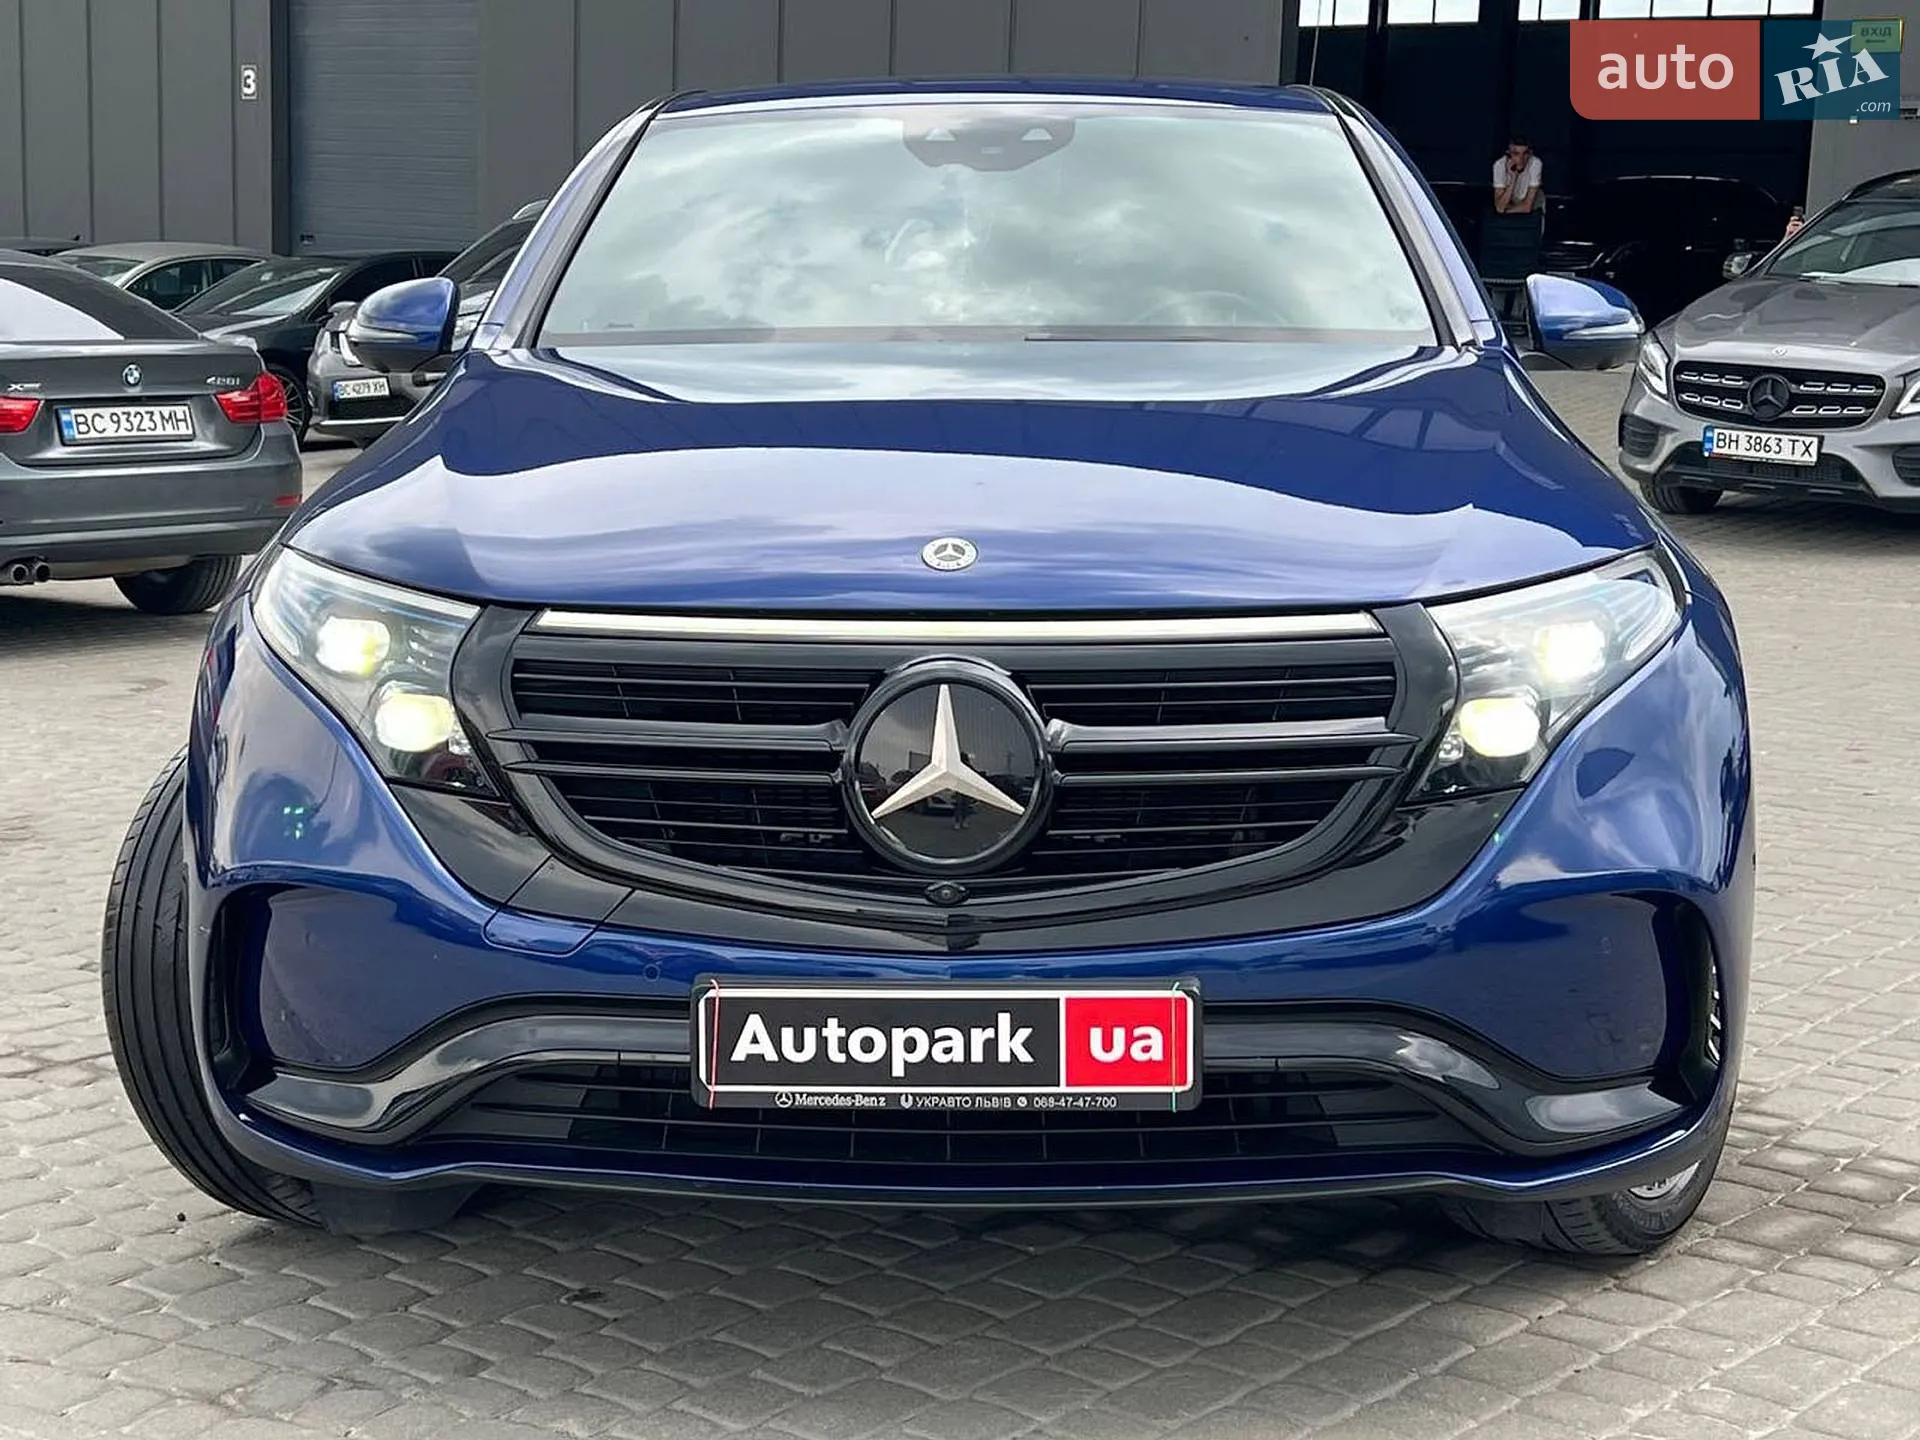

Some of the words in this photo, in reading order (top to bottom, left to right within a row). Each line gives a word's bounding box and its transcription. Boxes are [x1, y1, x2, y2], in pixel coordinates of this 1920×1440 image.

[243, 69, 256, 95] 3
[74, 413, 107, 435] BC
[111, 411, 158, 434] 9323
[161, 409, 190, 432] MH
[1716, 432, 1740, 450] BH
[1744, 434, 1782, 455] 3863
[1788, 438, 1815, 458] TX
[730, 1012, 1034, 1078] Autopark
[1089, 1025, 1164, 1064] ua
[795, 1094, 886, 1107] Mercedes-Benz
[916, 1096, 971, 1108] УКРАВТО
